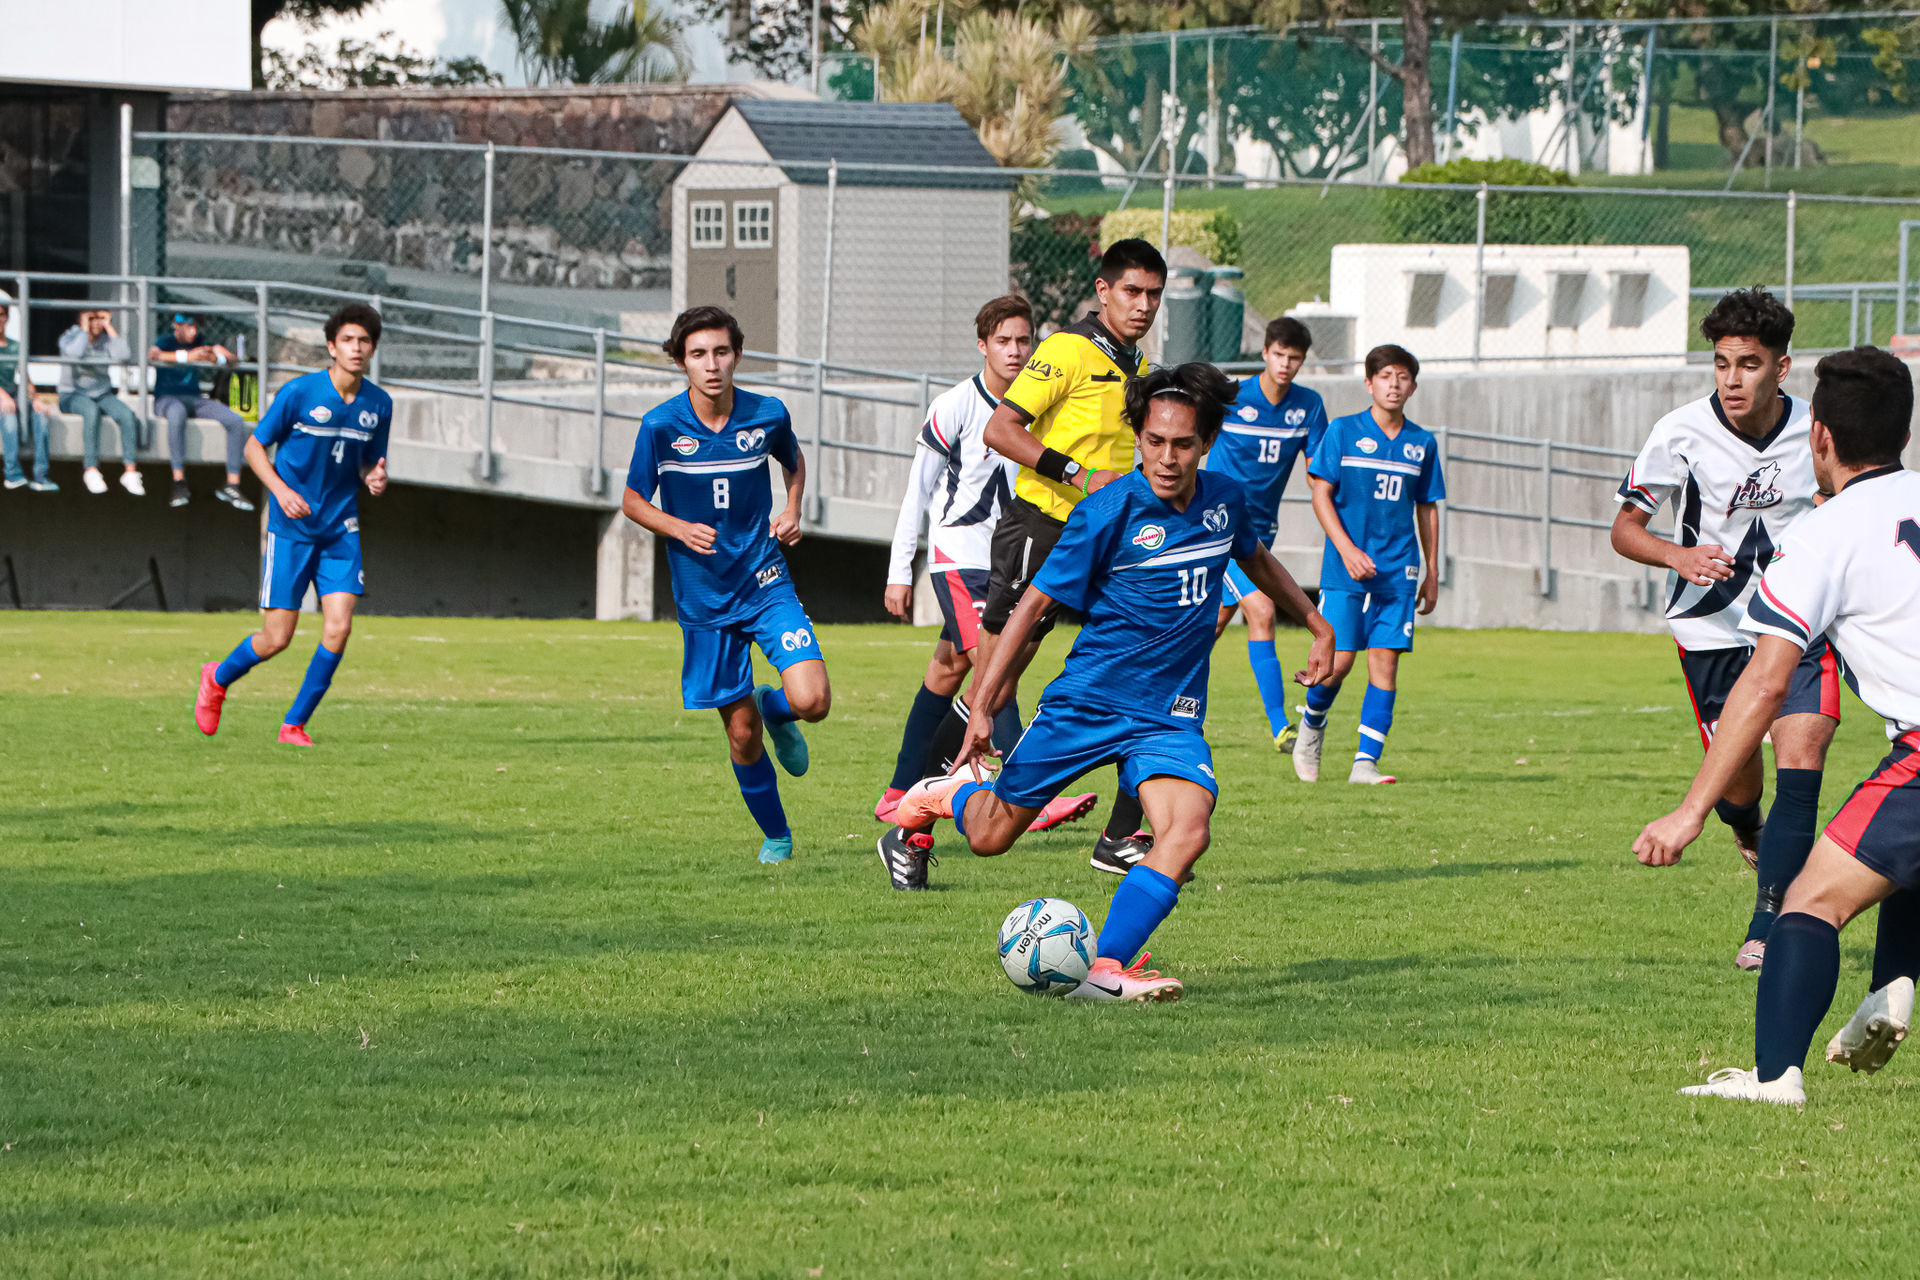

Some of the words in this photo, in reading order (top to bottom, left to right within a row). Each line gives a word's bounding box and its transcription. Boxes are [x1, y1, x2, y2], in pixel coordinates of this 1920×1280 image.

[331, 440, 345, 464] 4
[1257, 439, 1281, 464] 19
[713, 478, 730, 509] 8
[1374, 473, 1402, 502] 30
[1729, 484, 1775, 509] Lobos
[1178, 566, 1209, 607] 10
[1017, 913, 1052, 954] molten
